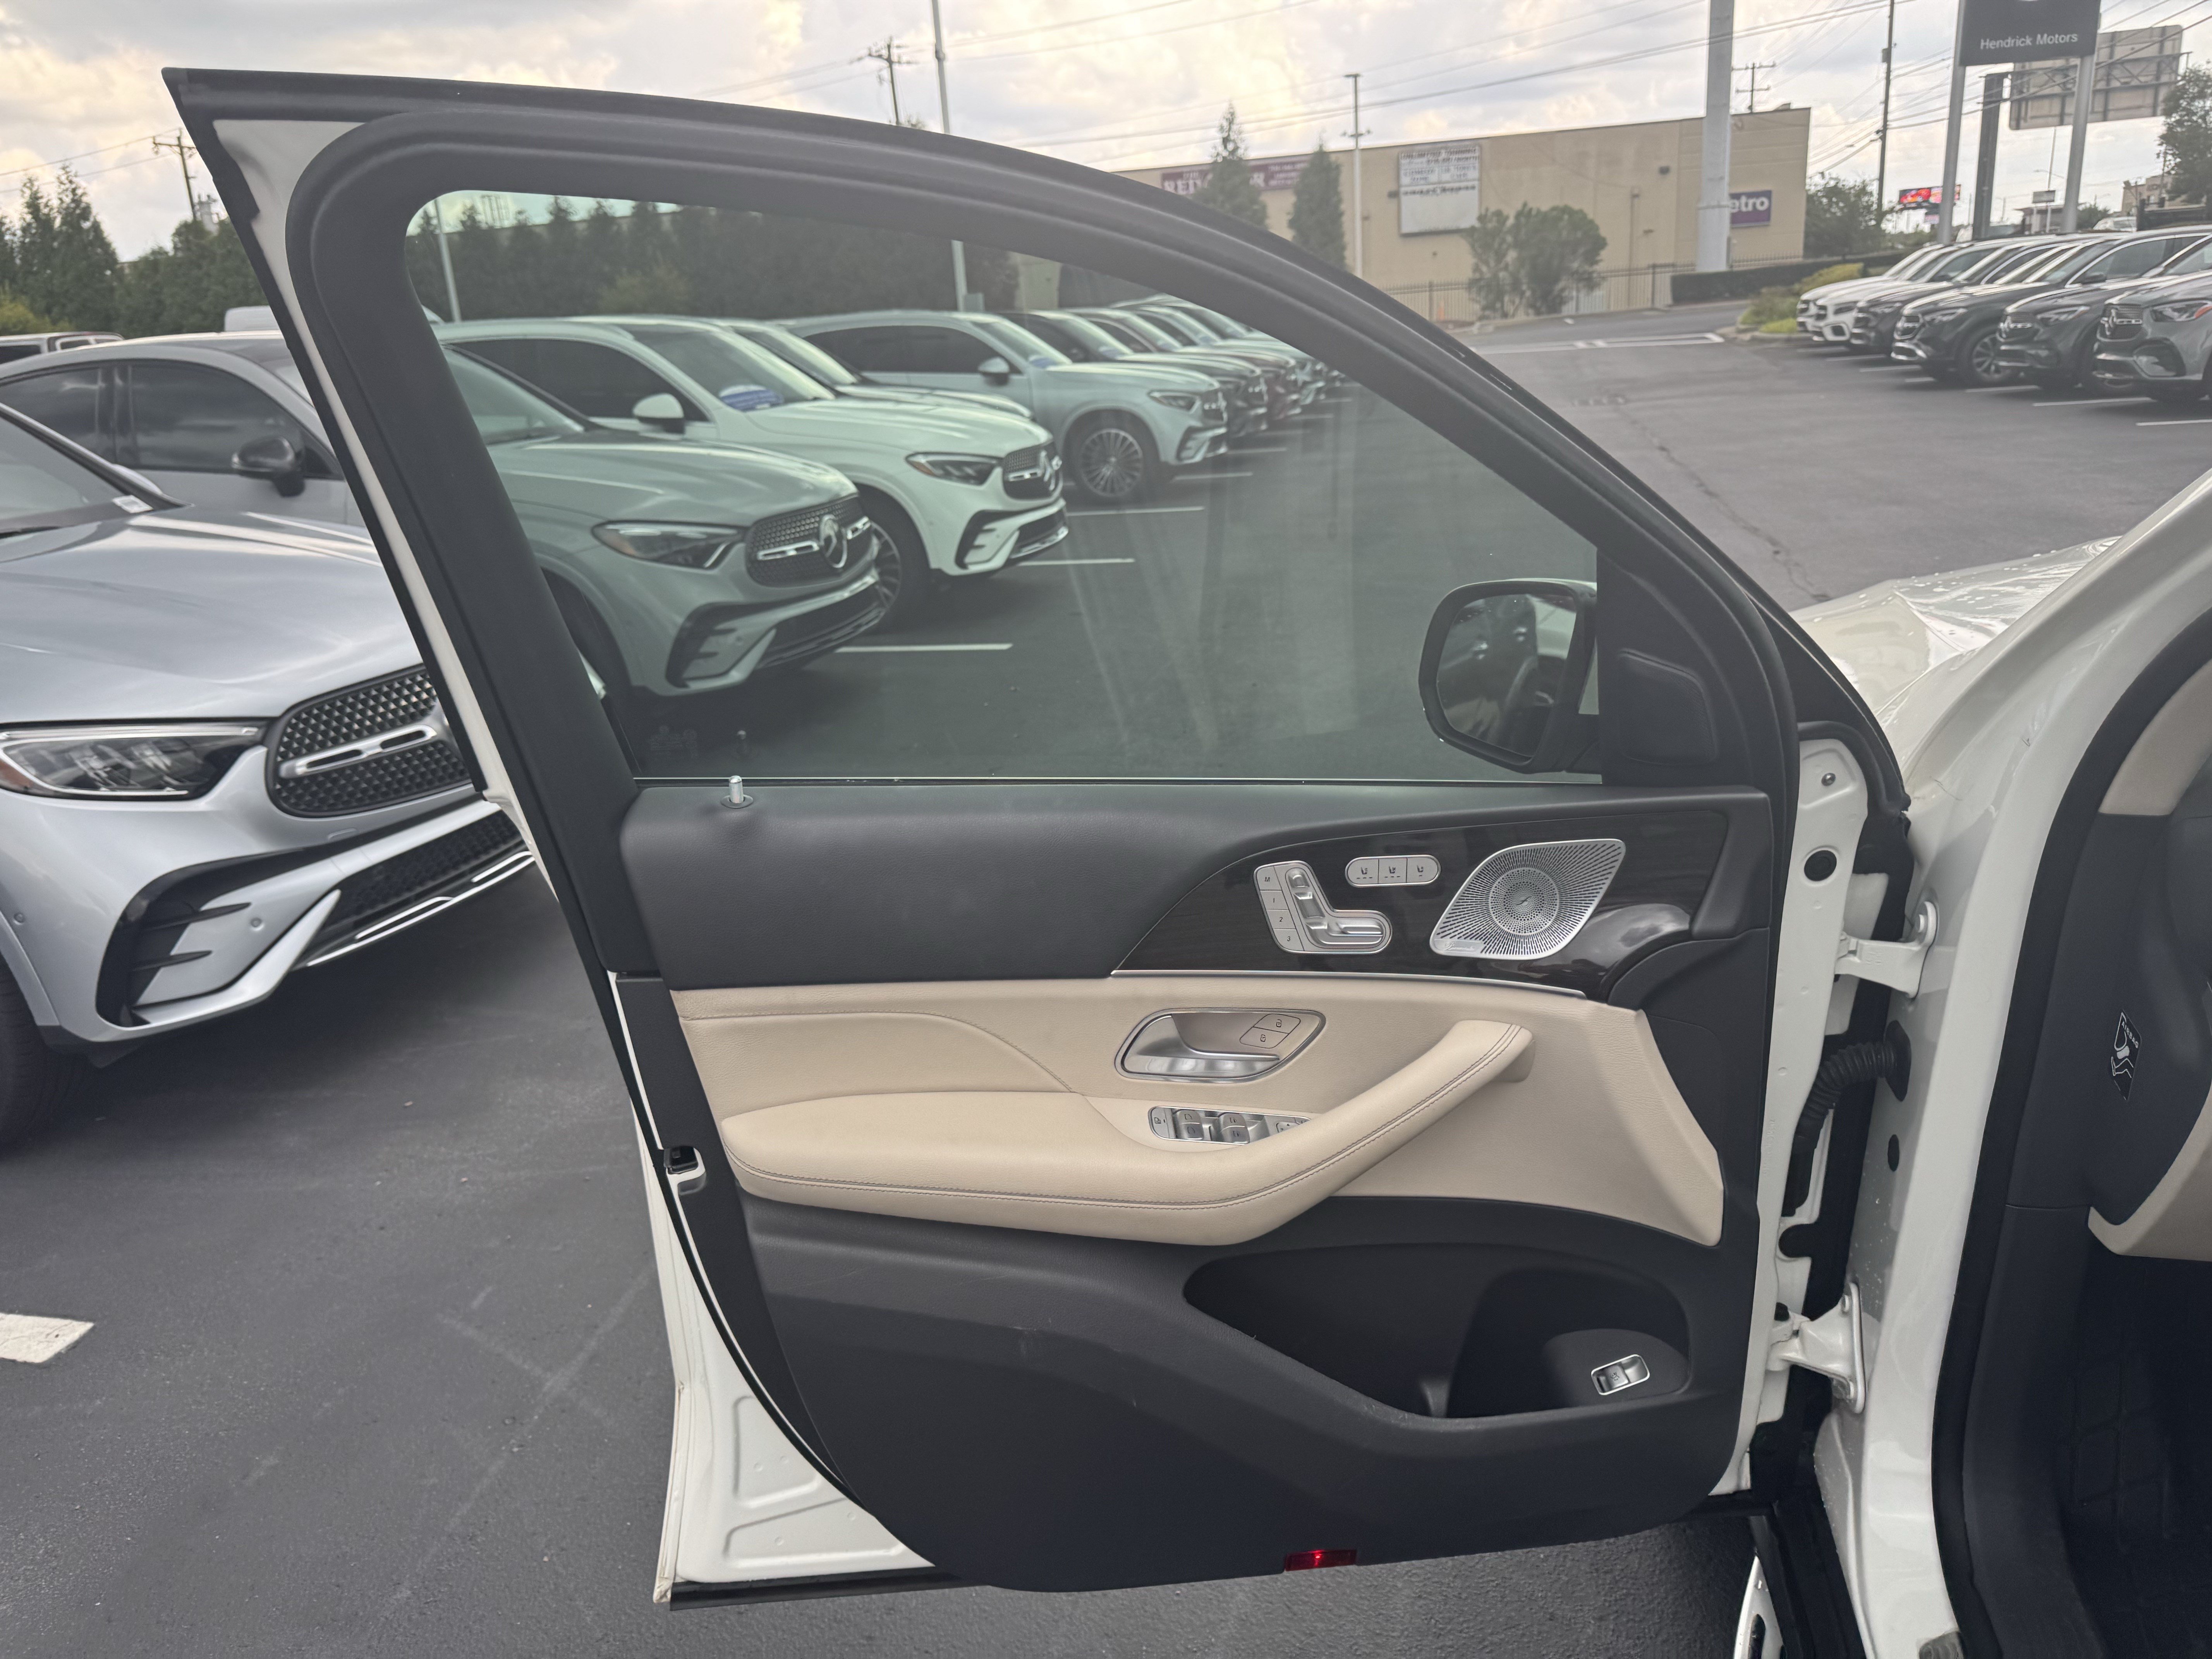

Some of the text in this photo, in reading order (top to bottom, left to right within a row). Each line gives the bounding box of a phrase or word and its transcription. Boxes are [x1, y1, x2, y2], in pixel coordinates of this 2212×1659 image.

[1980, 33, 2078, 50] Hendrick Motors
[1729, 195, 1769, 213] etro
